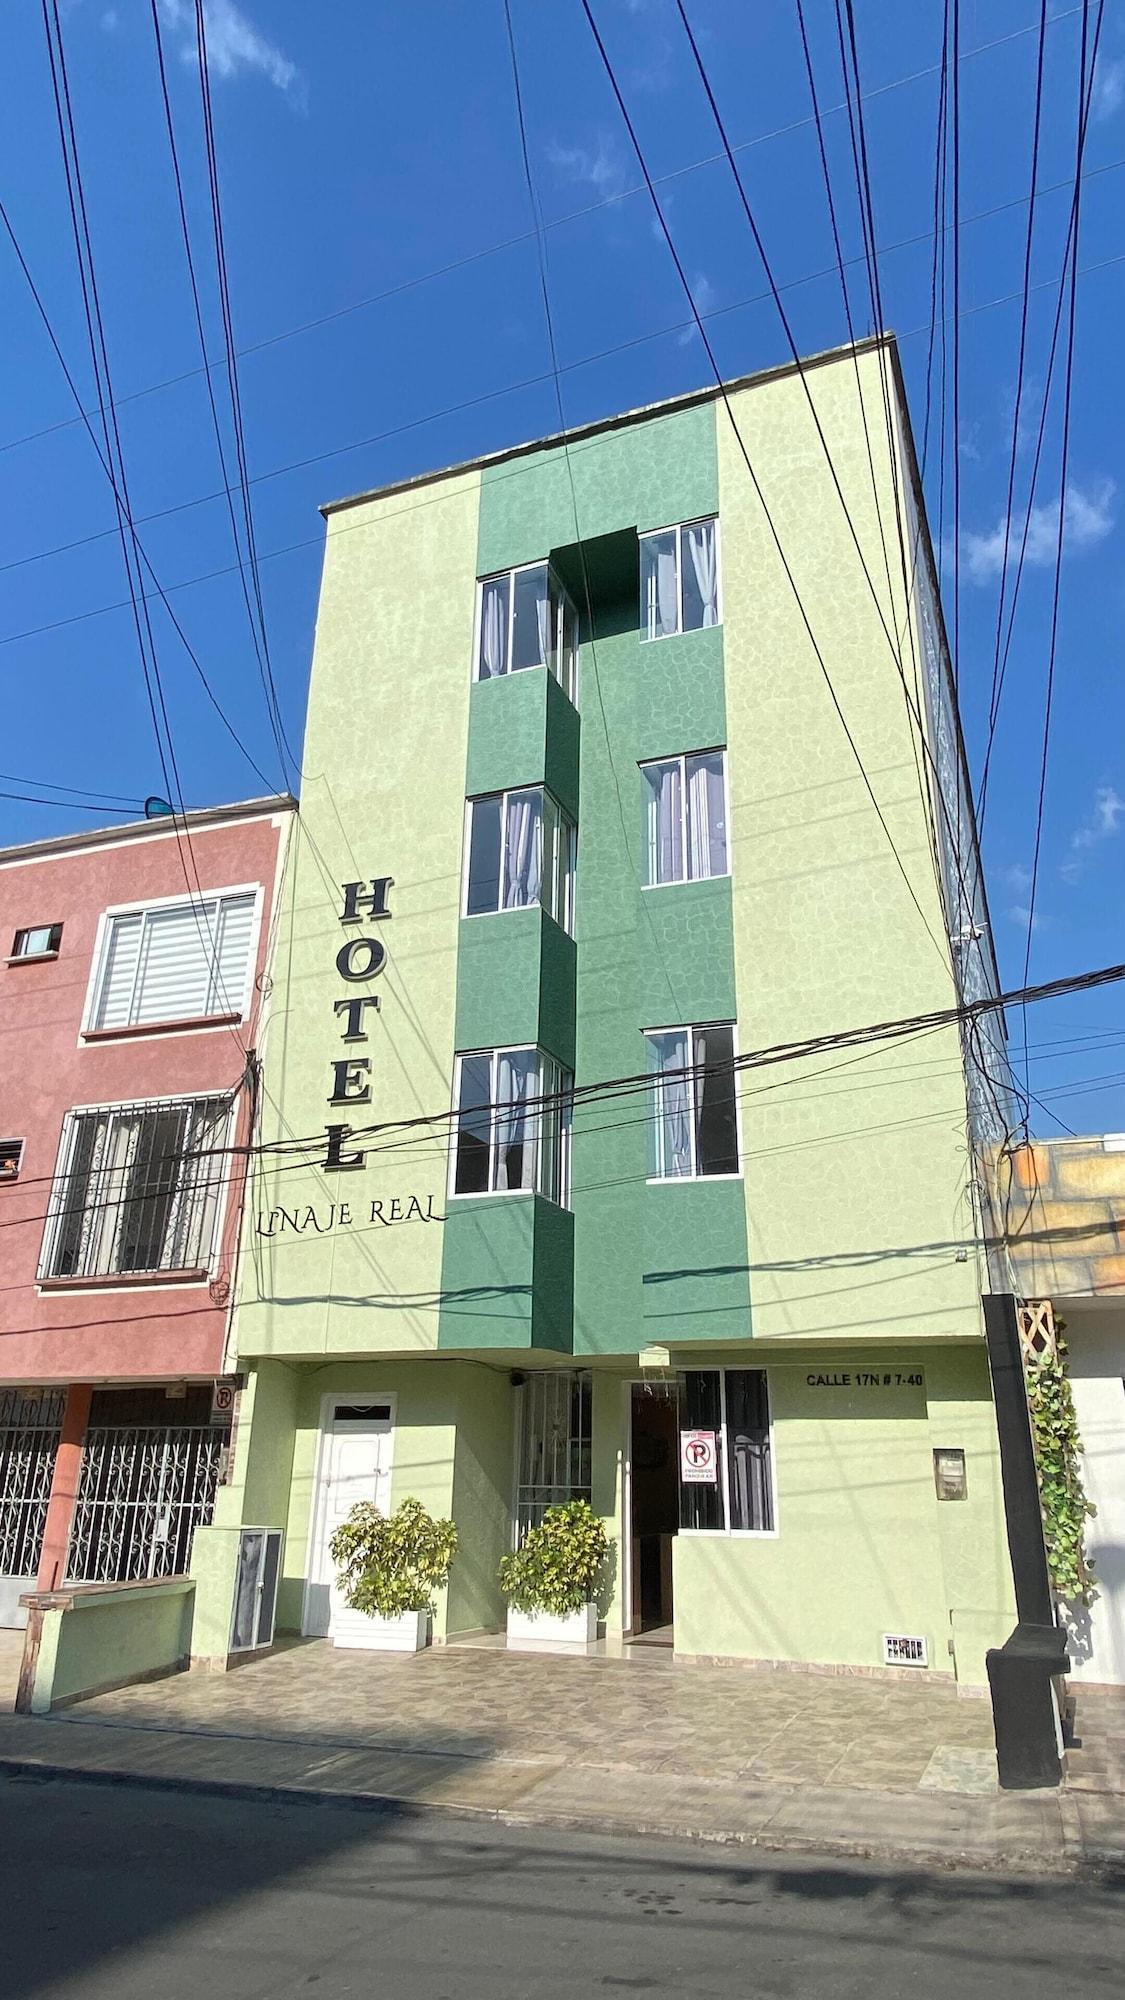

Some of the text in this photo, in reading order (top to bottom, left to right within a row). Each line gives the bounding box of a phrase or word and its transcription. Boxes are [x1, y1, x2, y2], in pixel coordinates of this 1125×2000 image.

[321, 876, 394, 1173] HOTEL
[256, 1195, 449, 1237] LINAJE REAL
[806, 1374, 923, 1386] CALLE 17N # 7-40
